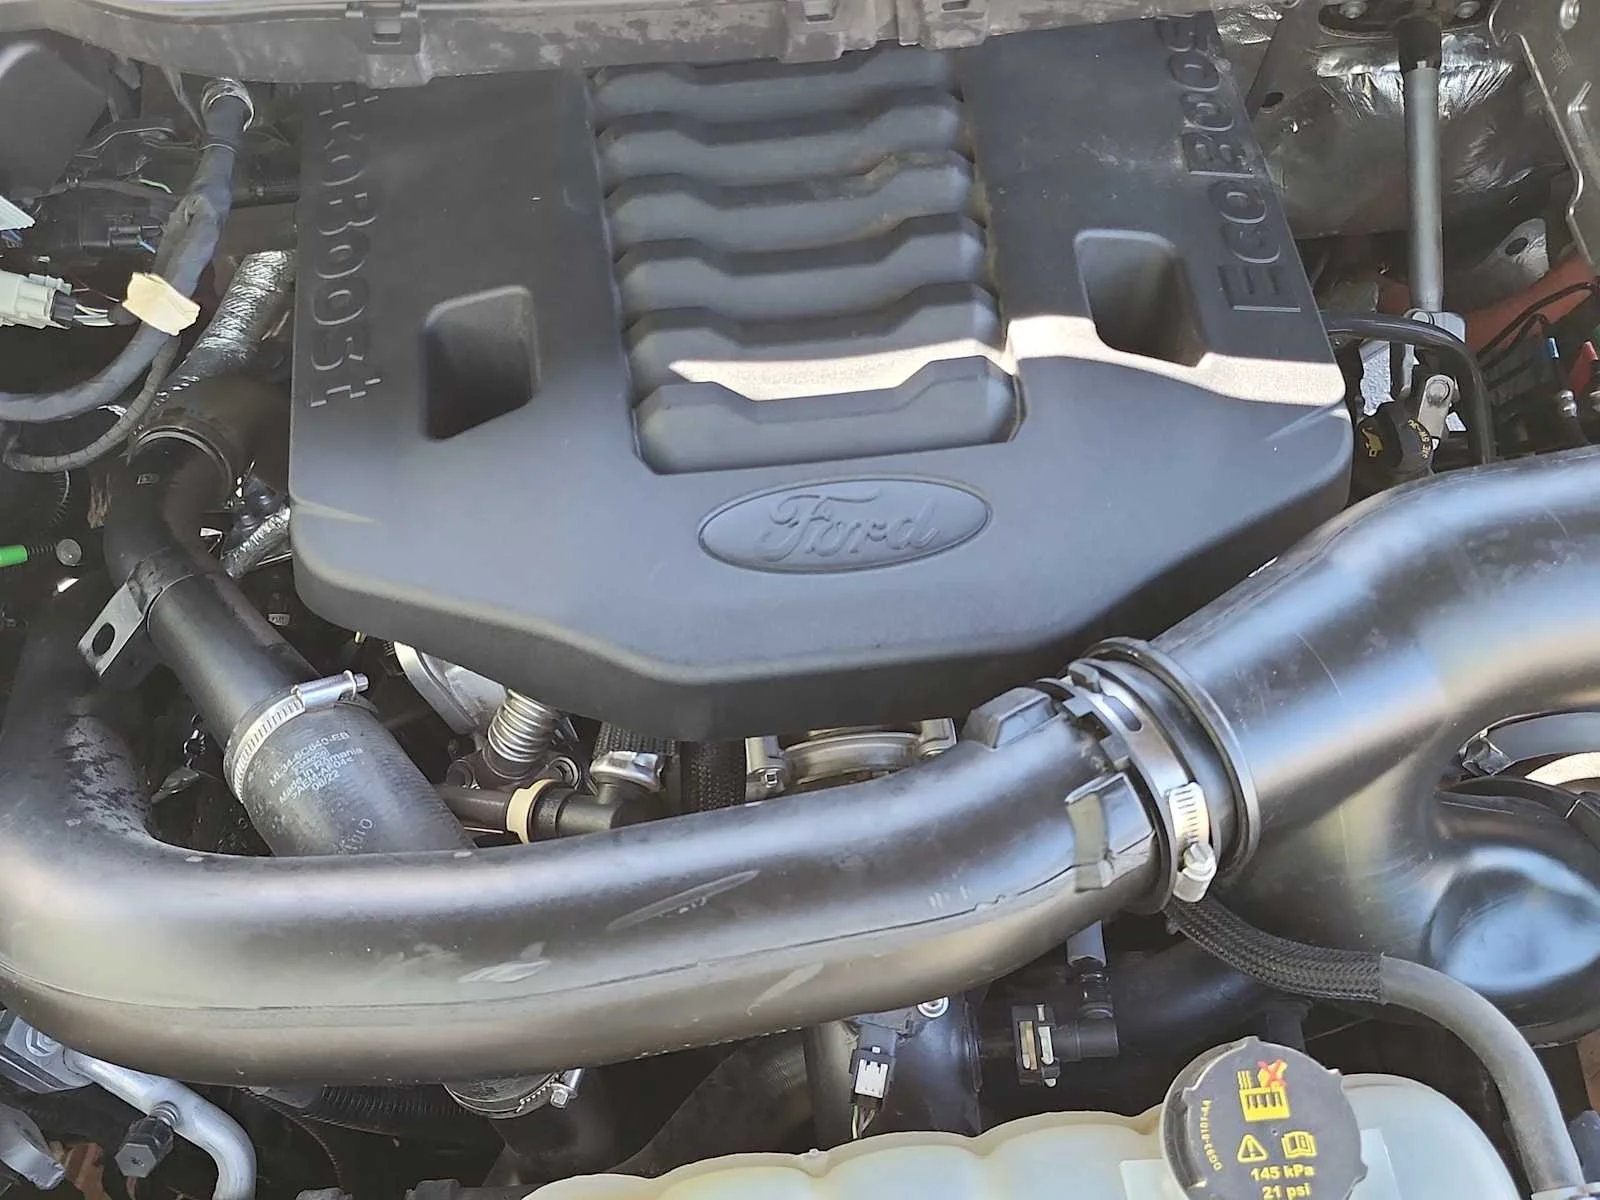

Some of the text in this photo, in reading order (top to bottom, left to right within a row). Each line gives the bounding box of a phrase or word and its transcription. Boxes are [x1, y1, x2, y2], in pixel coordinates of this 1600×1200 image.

[1154, 14, 1302, 314] ECOBOOS
[754, 488, 939, 562] Ford
[279, 774, 303, 803] Made
[315, 746, 364, 771] Romania
[1250, 1164, 1315, 1181] 145 kPa
[1262, 1182, 1311, 1200] 21 psi
